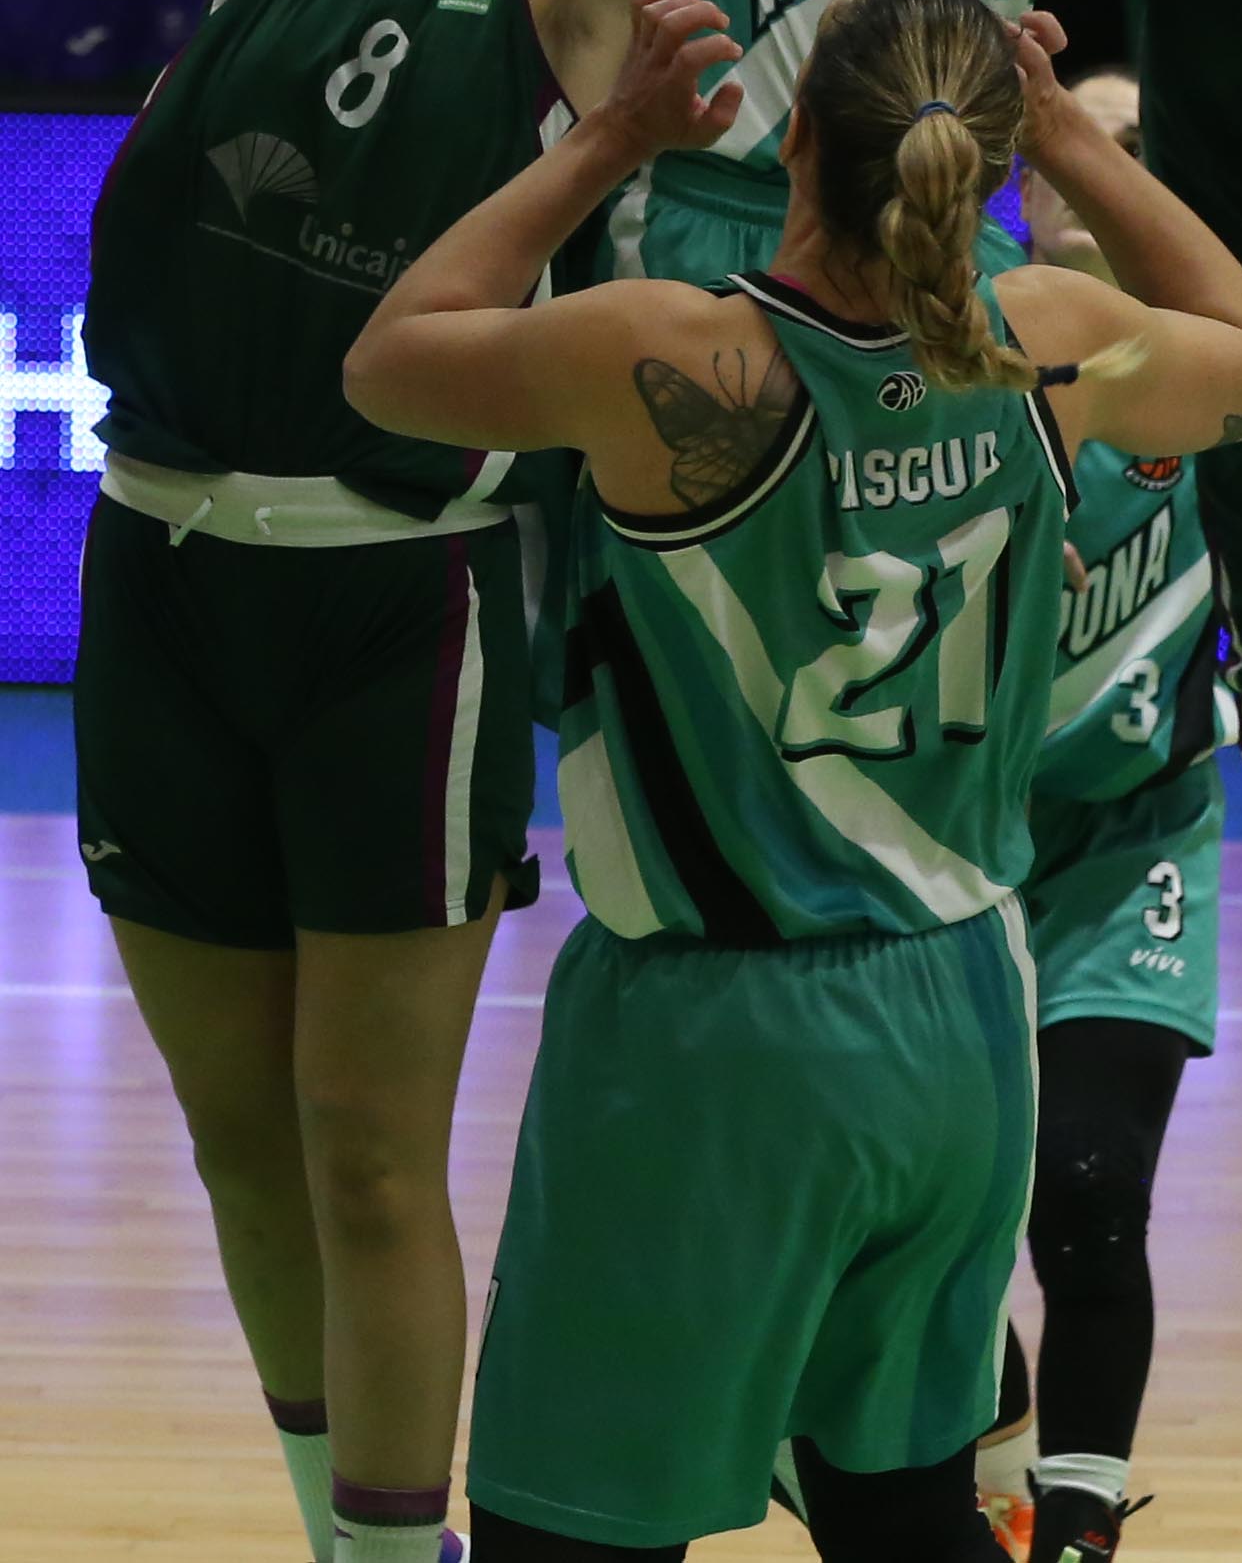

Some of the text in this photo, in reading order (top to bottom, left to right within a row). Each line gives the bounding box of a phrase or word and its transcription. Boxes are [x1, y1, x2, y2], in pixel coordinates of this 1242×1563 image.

[325, 19, 410, 128] 8
[298, 213, 411, 290] Unicaj
[1111, 658, 1160, 744] 3
[1143, 860, 1184, 940] 3
